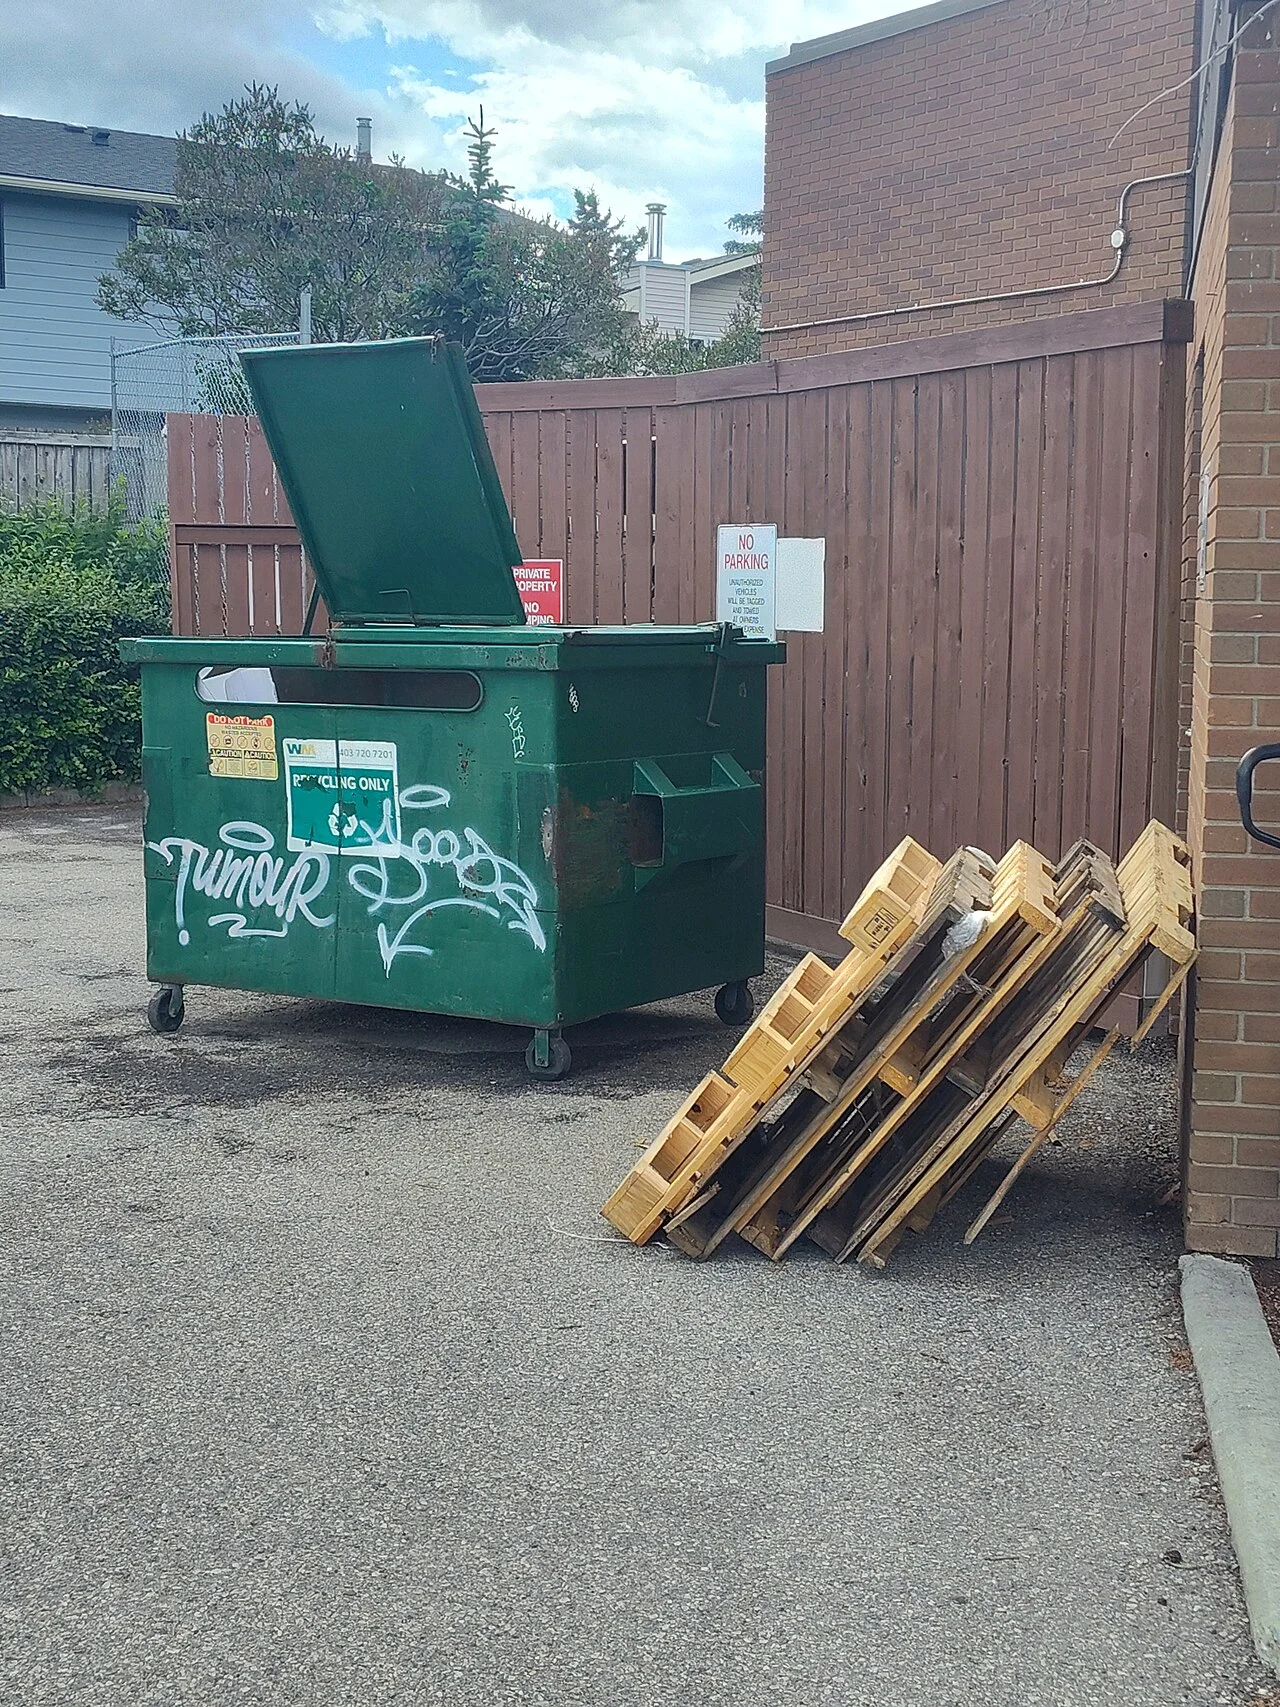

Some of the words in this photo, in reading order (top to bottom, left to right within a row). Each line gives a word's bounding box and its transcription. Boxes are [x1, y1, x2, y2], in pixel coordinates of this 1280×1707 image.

[738, 533, 754, 550] NO
[724, 553, 769, 570] PARKING
[513, 568, 551, 579] PRIVATE
[516, 580, 557, 592] OPERTY
[739, 597, 745, 605] BE
[524, 602, 540, 613] NO
[213, 715, 226, 724] DO
[227, 716, 245, 726] NOT
[216, 749, 242, 758] CAUTION
[287, 743, 315, 756] WM
[355, 749, 371, 758] 720
[372, 751, 393, 759] 7201
[250, 752, 276, 760] CAUTION
[358, 776, 390, 792] ONLY
